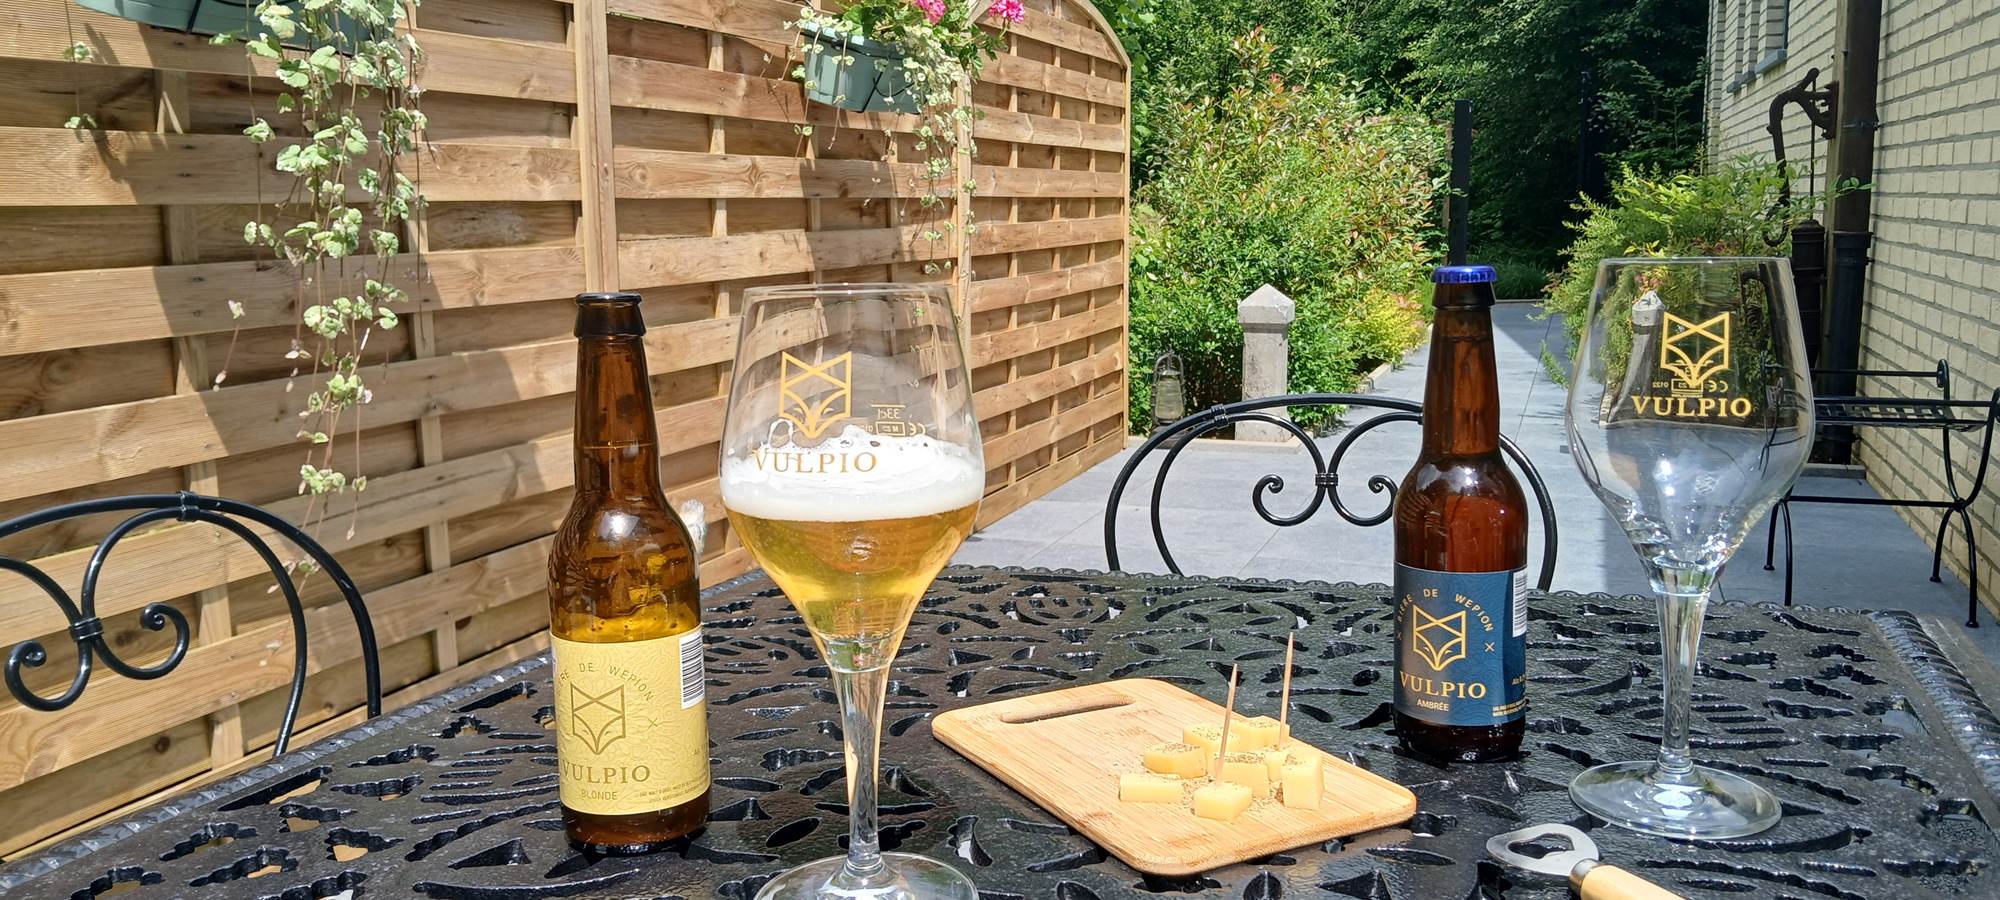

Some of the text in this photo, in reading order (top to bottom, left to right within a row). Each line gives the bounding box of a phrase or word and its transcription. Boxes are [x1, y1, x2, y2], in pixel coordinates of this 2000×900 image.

[1631, 395, 1753, 417] VULPIO
[752, 449, 878, 474] VULPIO
[1423, 588, 1439, 598] DE
[1455, 593, 1494, 632] WEPION
[578, 662, 595, 673] DE
[609, 664, 655, 701] WEPION
[1400, 671, 1487, 699] VULPIO
[1416, 698, 1450, 712] AMBRÉE
[561, 758, 650, 784] VULPIO
[581, 788, 618, 801] BLONDE
